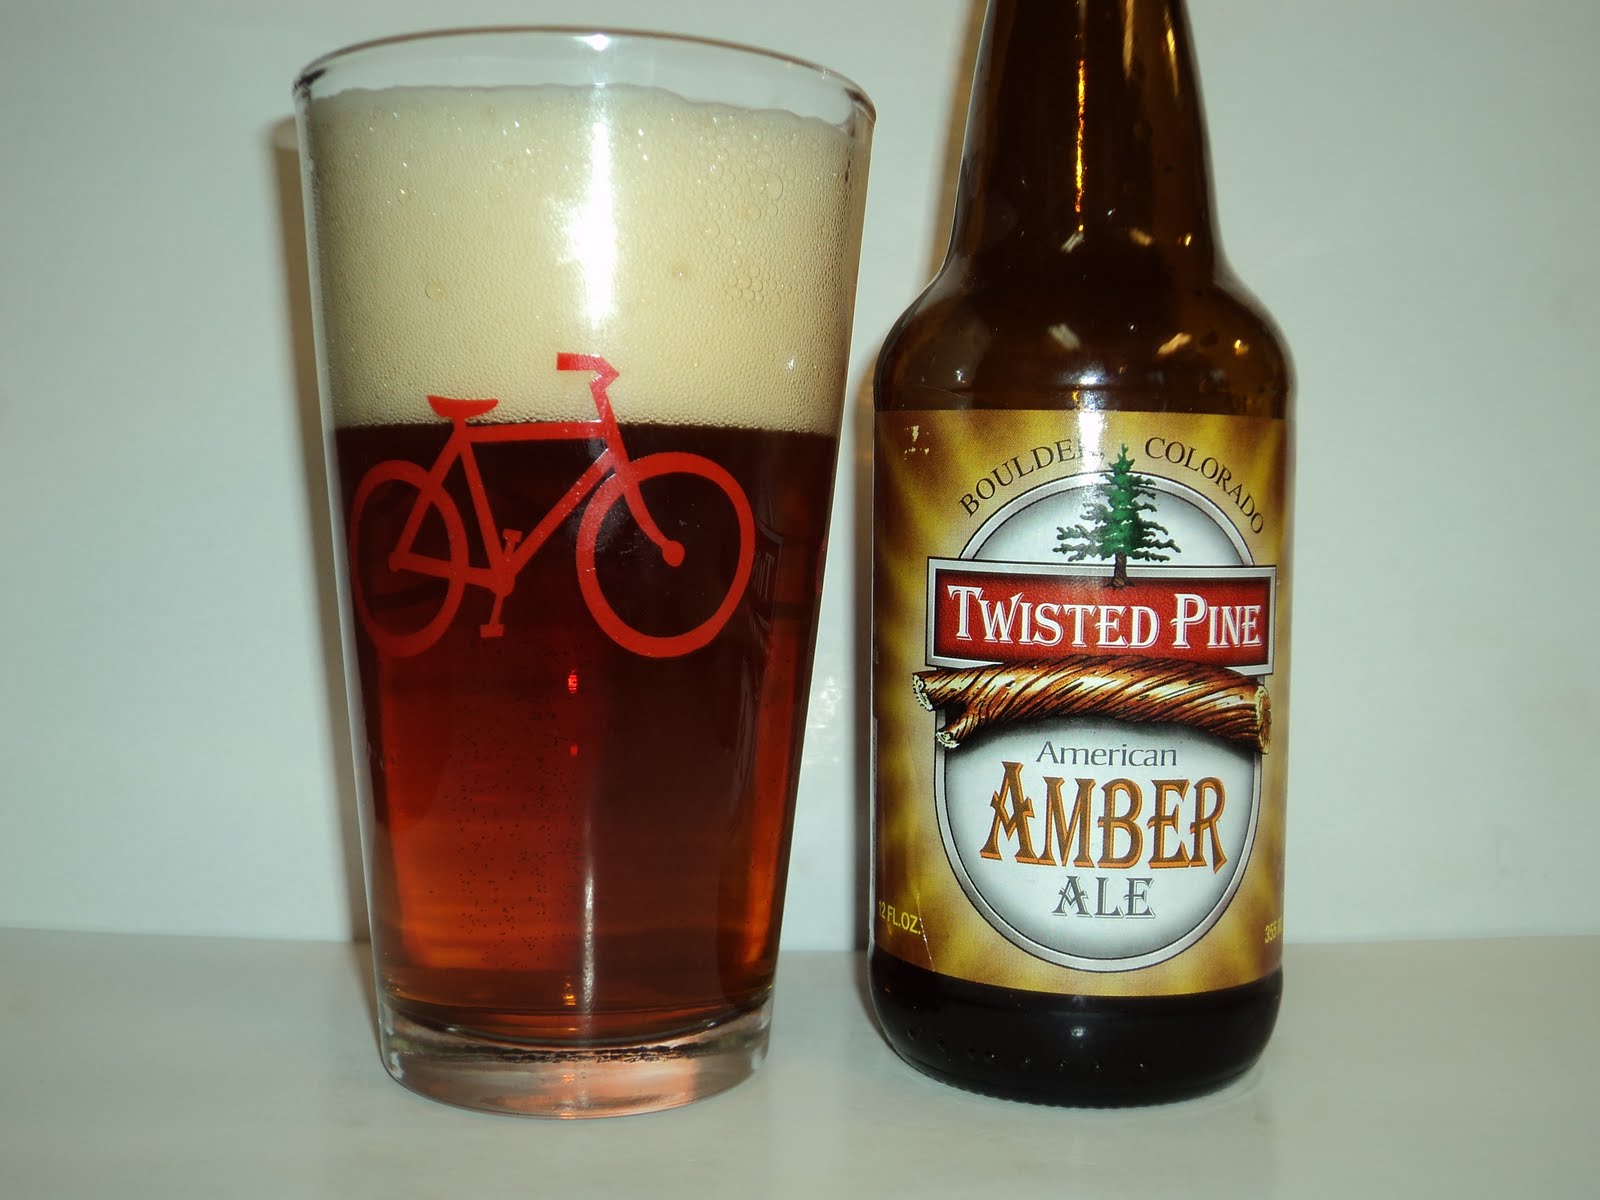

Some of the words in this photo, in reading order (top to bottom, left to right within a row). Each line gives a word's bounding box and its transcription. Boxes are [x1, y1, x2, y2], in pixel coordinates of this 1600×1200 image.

[1145, 436, 1264, 534] COLORADO
[947, 585, 1160, 648] TWISTED
[1170, 593, 1262, 649] PINE
[1036, 740, 1177, 767] American
[979, 760, 1228, 874] AMBER
[1051, 875, 1156, 920] ALE
